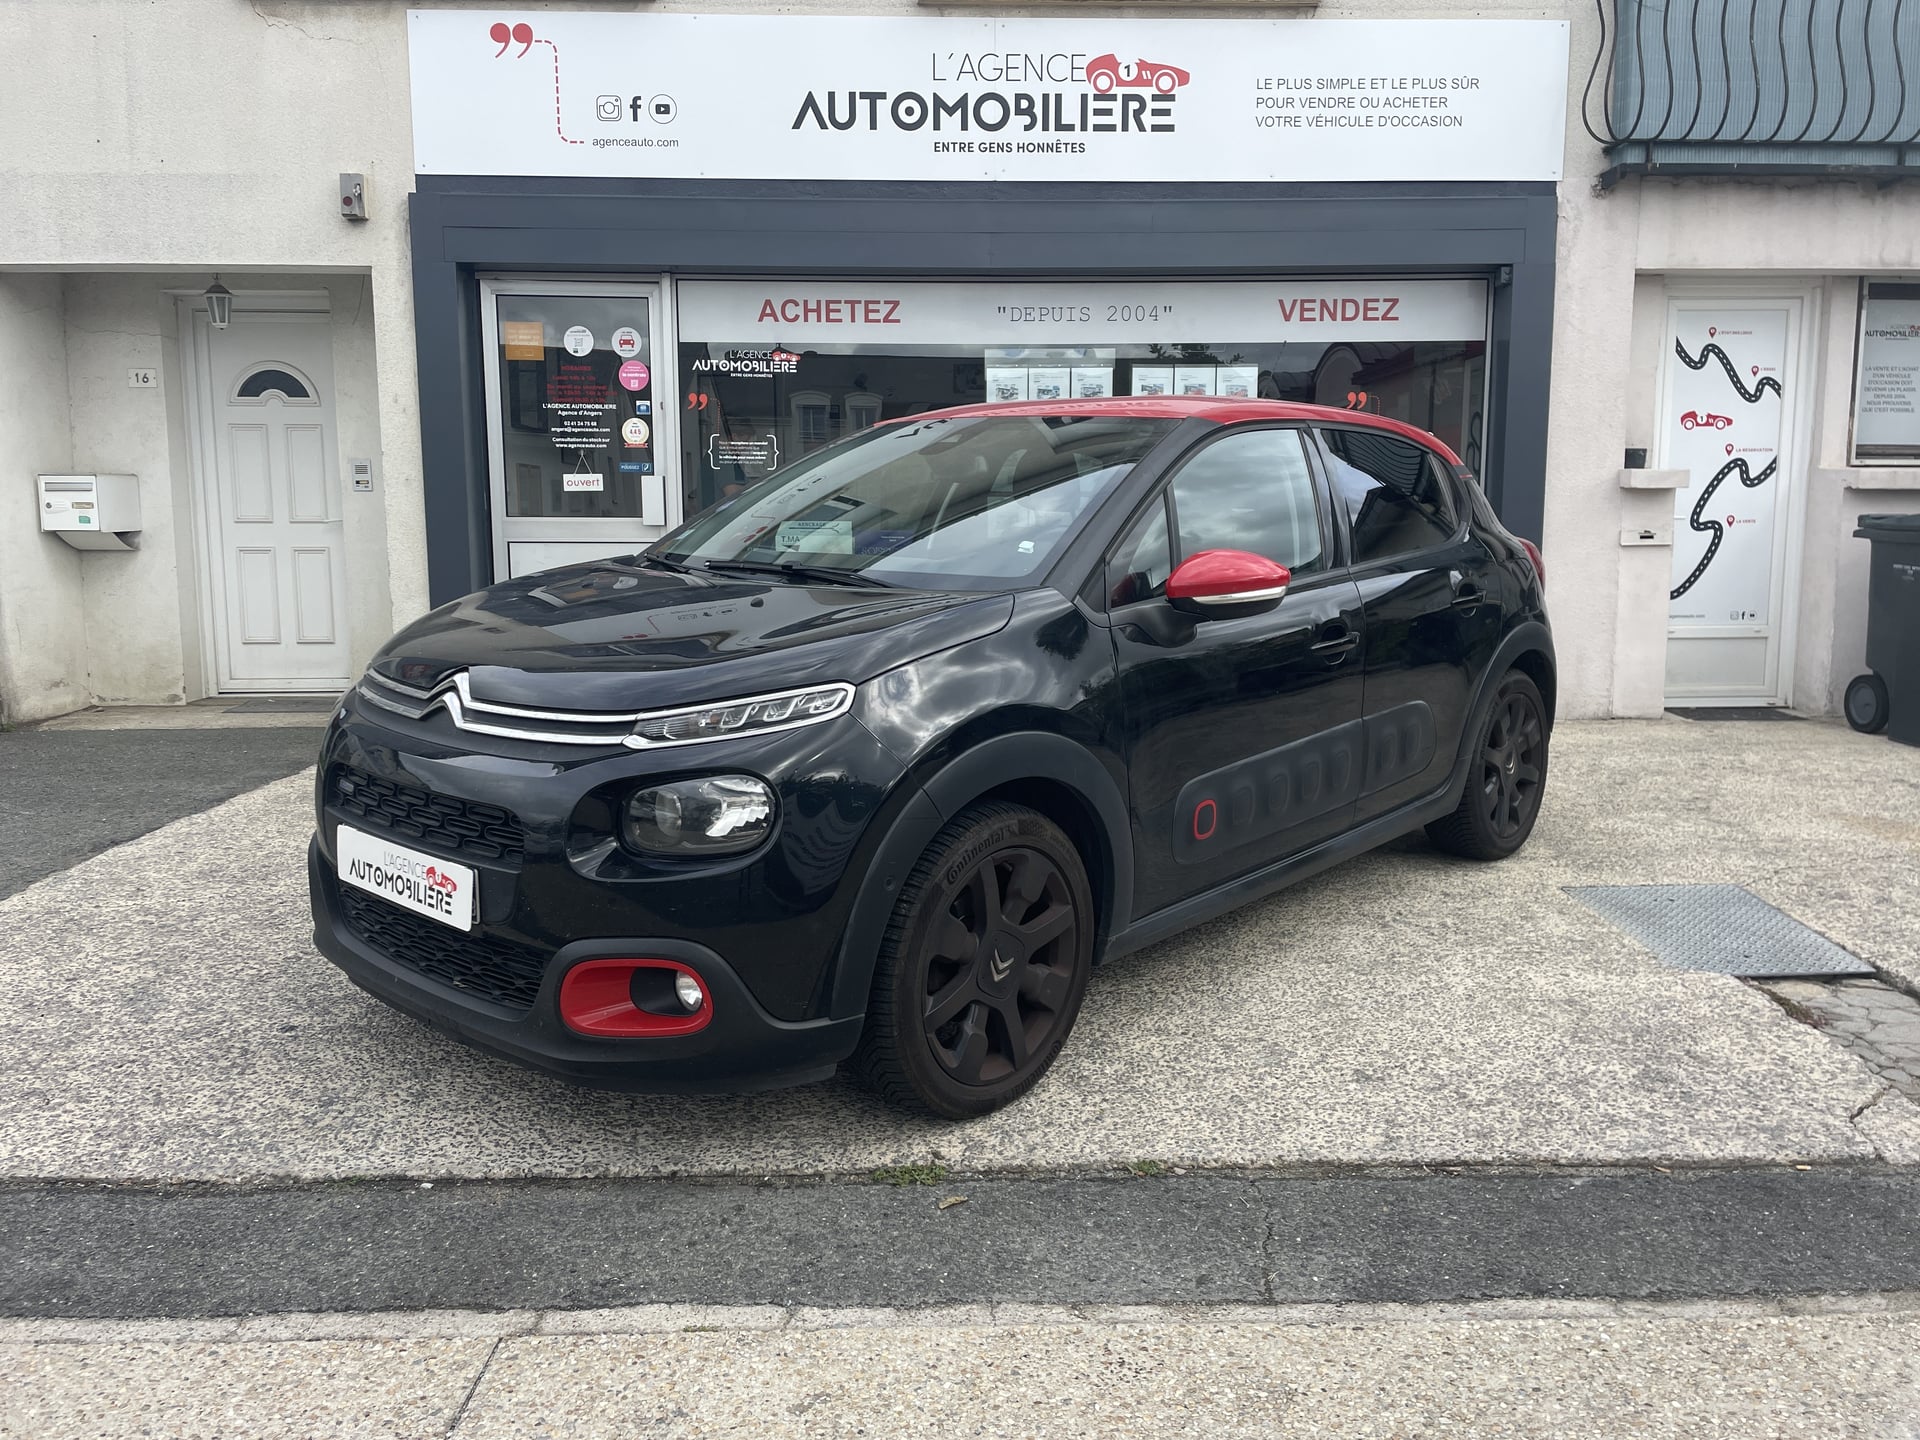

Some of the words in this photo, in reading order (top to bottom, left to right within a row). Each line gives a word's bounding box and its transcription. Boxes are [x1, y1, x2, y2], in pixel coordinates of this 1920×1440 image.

[1256, 78, 1273, 90] LE
[1276, 78, 1313, 90] PLUS
[1316, 78, 1366, 90] SIMPLE
[1370, 78, 1388, 89] ET
[1391, 78, 1408, 89] LE
[1411, 77, 1448, 89] PLUS
[1450, 75, 1480, 89] SÛR
[1256, 97, 1295, 109] POUR
[1299, 97, 1356, 109] VENDRE
[1359, 97, 1380, 109] OU
[1382, 97, 1448, 109] ACHETER
[1255, 116, 1302, 128] VOTRE
[1306, 113, 1374, 128] VÉHICULE
[1378, 115, 1463, 128] D'OCCASION
[592, 137, 679, 149] agenceauto.com
[933, 141, 975, 153] ENTRE
[977, 141, 1013, 153] GENS
[1016, 139, 1086, 154] HONNÊTES
[758, 298, 901, 324] ACHETEZ
[1278, 297, 1401, 323] VENDEZ
[729, 350, 773, 360] L'AGENCE
[133, 372, 149, 384] 16
[566, 477, 600, 487] ouvert
[383, 850, 427, 881] L'AGENCE
